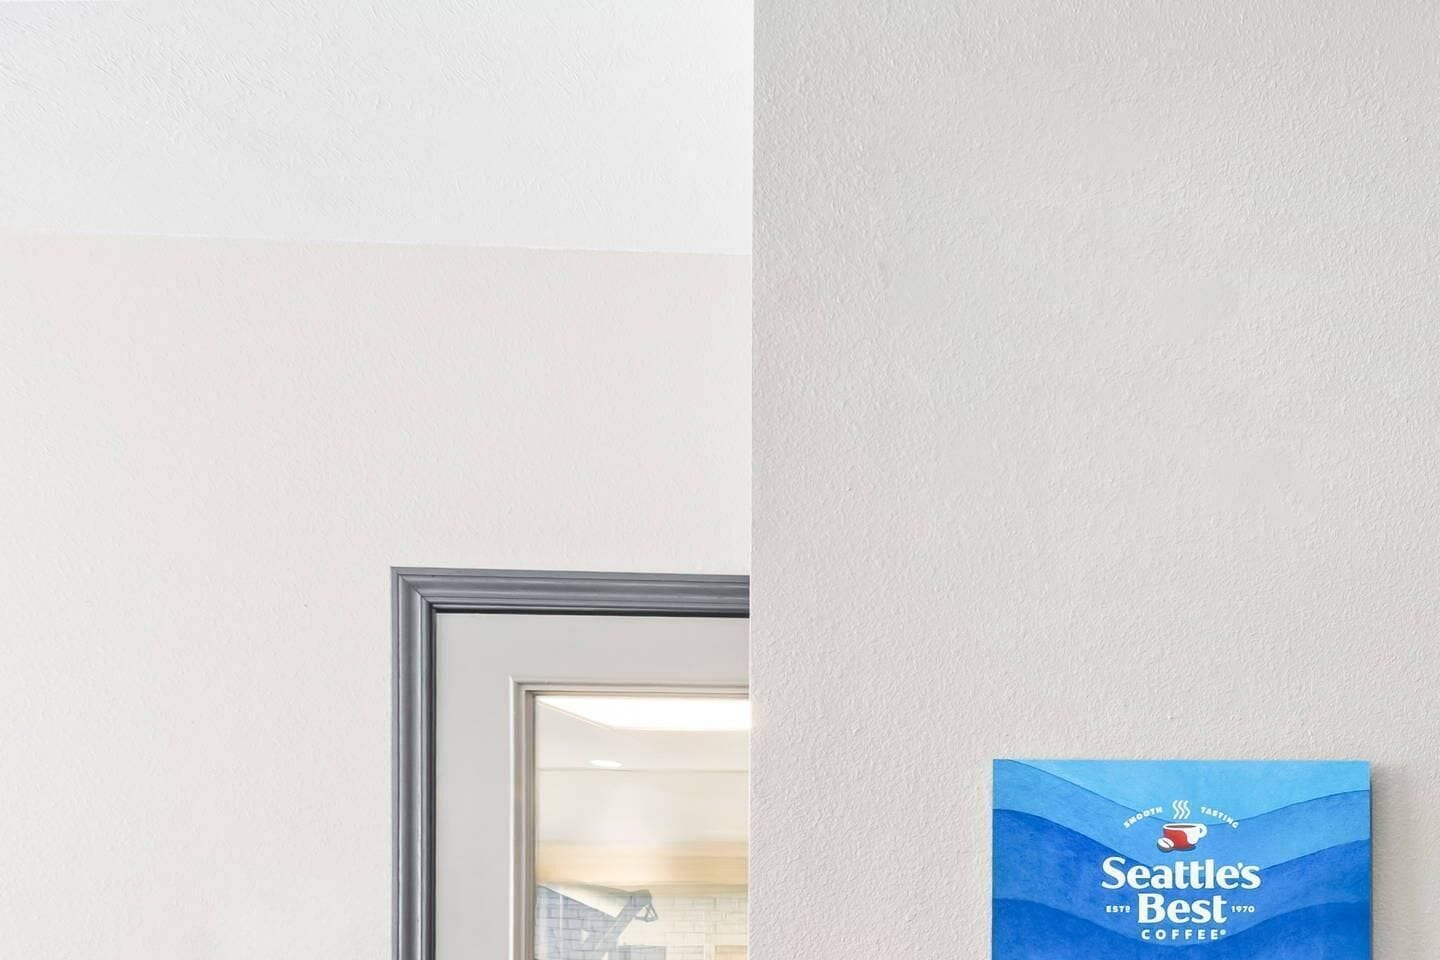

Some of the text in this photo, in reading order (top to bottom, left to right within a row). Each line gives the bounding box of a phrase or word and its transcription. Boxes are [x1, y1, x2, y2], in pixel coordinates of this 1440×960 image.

[1124, 807, 1239, 828] SMOOTH TASTING
[1101, 856, 1262, 890] Seattle's
[1137, 893, 1228, 924] Best
[1231, 905, 1256, 913] 1970
